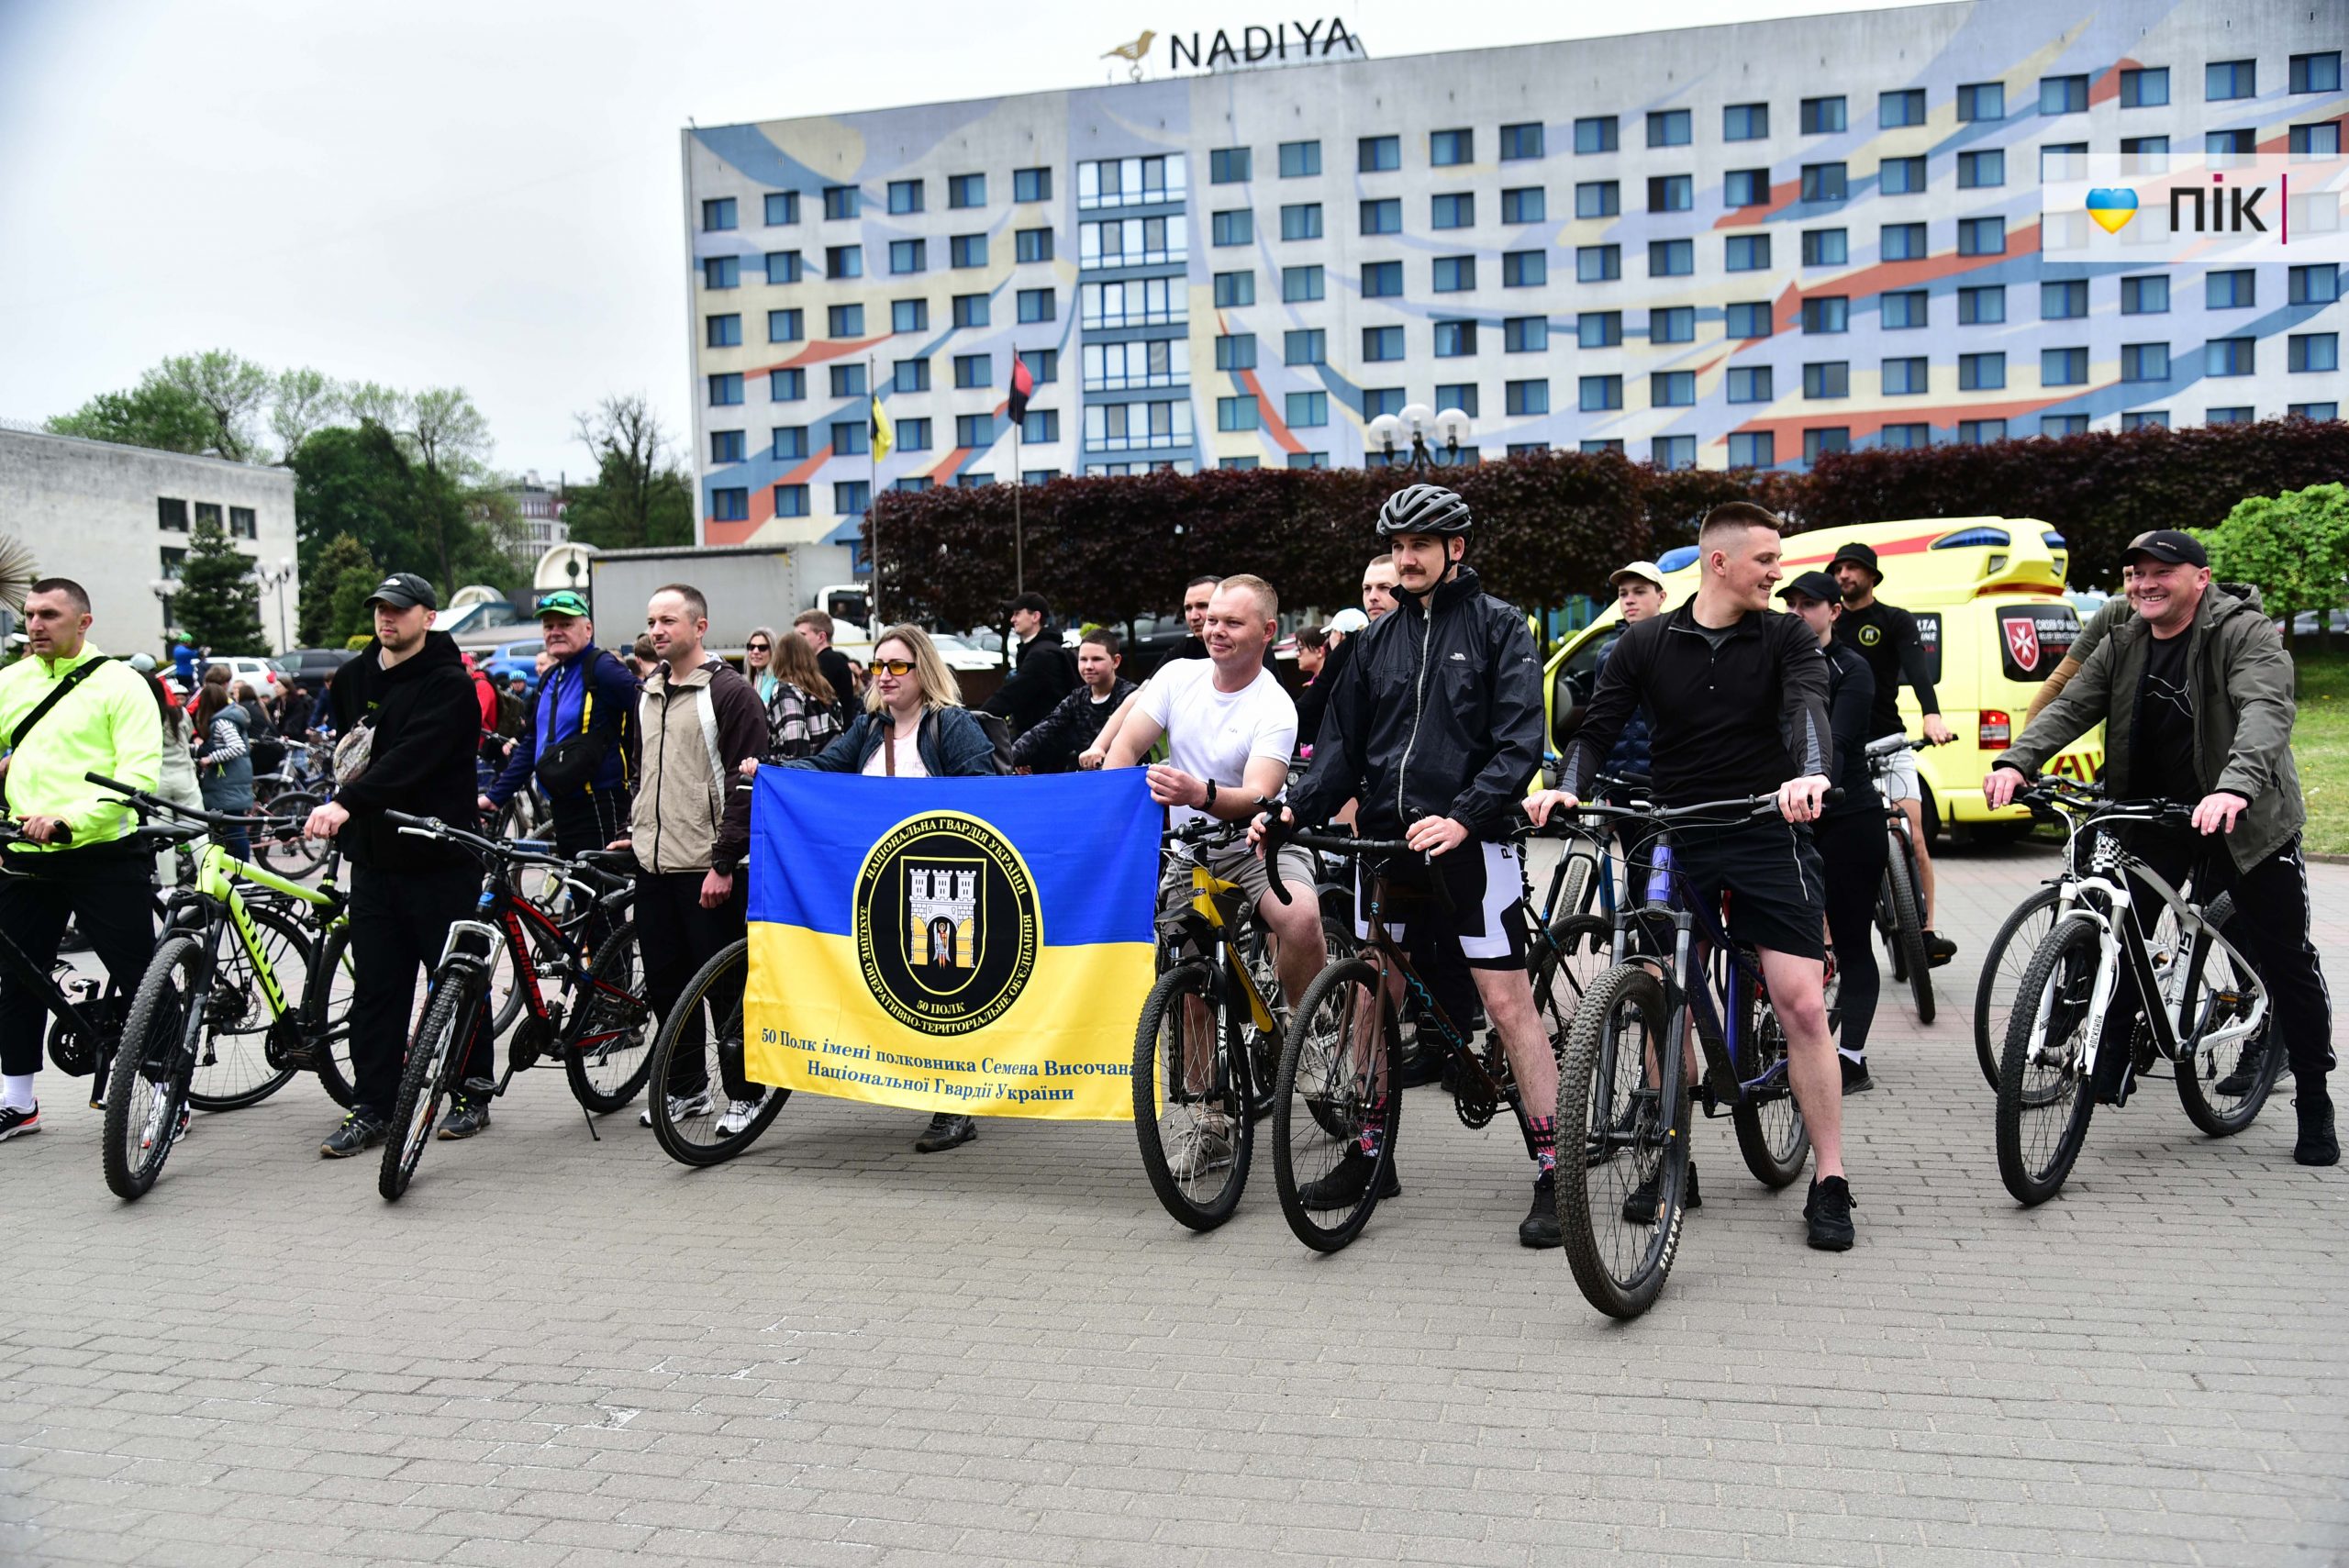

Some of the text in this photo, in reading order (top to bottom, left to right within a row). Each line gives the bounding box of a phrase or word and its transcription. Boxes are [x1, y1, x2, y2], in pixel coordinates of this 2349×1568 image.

[1171, 17, 1354, 70] NADIYA
[865, 818, 1028, 895] НАЦІОНАЛЬНА ГВАРДІЯ УКРАЇНИ
[859, 906, 871, 961] ЗАХІДНЕ
[916, 999, 965, 1015] 50 ПОЛК
[761, 1028, 777, 1044] 50
[779, 1029, 817, 1051] Полк
[822, 1038, 872, 1061] імені
[875, 1050, 976, 1073] полковника
[981, 1057, 1039, 1076] Семена
[807, 1060, 1074, 1104] Національної Гвардії України
[1659, 1205, 1682, 1271] MAXXIS
